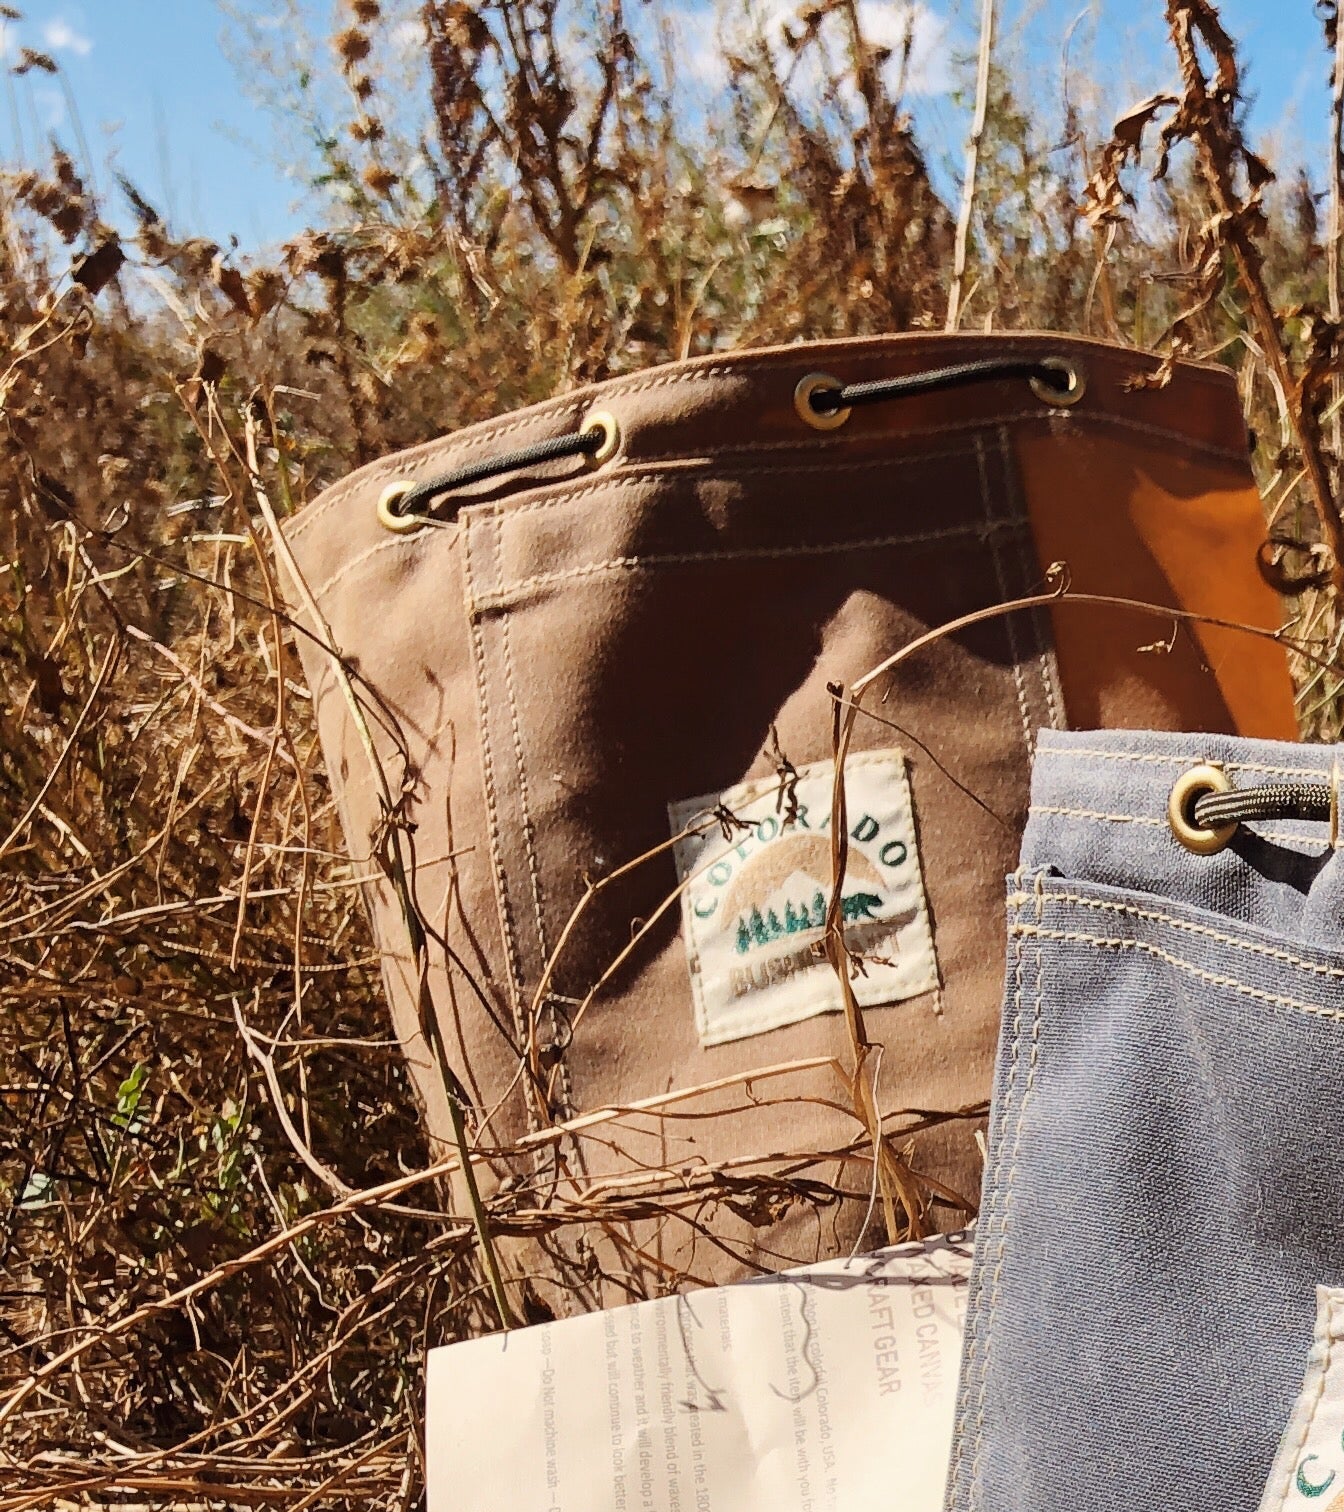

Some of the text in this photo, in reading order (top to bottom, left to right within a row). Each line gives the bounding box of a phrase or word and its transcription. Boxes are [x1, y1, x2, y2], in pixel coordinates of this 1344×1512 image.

[780, 1294, 798, 1328] intent
[605, 1340, 619, 1359] but
[631, 1332, 643, 1345] to
[784, 1330, 799, 1354] that
[607, 1361, 621, 1381] will
[632, 1347, 646, 1392] weather
[786, 1356, 800, 1376] the
[810, 1342, 829, 1385] colorful
[874, 1335, 902, 1398] GEAR
[916, 1323, 942, 1408] CANVAS
[542, 1386, 556, 1408] Not
[608, 1382, 623, 1432] continue
[634, 1394, 649, 1416] and
[660, 1382, 676, 1424] friendly
[792, 1407, 808, 1427] will
[816, 1388, 832, 1444] Colorado,
[542, 1410, 558, 1456] machine
[612, 1433, 624, 1445] to
[637, 1429, 652, 1448] will
[663, 1426, 677, 1460] blend
[794, 1429, 808, 1445] be
[612, 1448, 626, 1472] look
[692, 1449, 706, 1461] in
[796, 1447, 811, 1472] with
[822, 1446, 836, 1473] USA.
[546, 1458, 561, 1489] wash
[638, 1451, 655, 1498] develop
[666, 1462, 681, 1475] of
[693, 1464, 708, 1484] the
[612, 1474, 628, 1512] better
[796, 1474, 811, 1496] you
[642, 1500, 653, 1508] a
